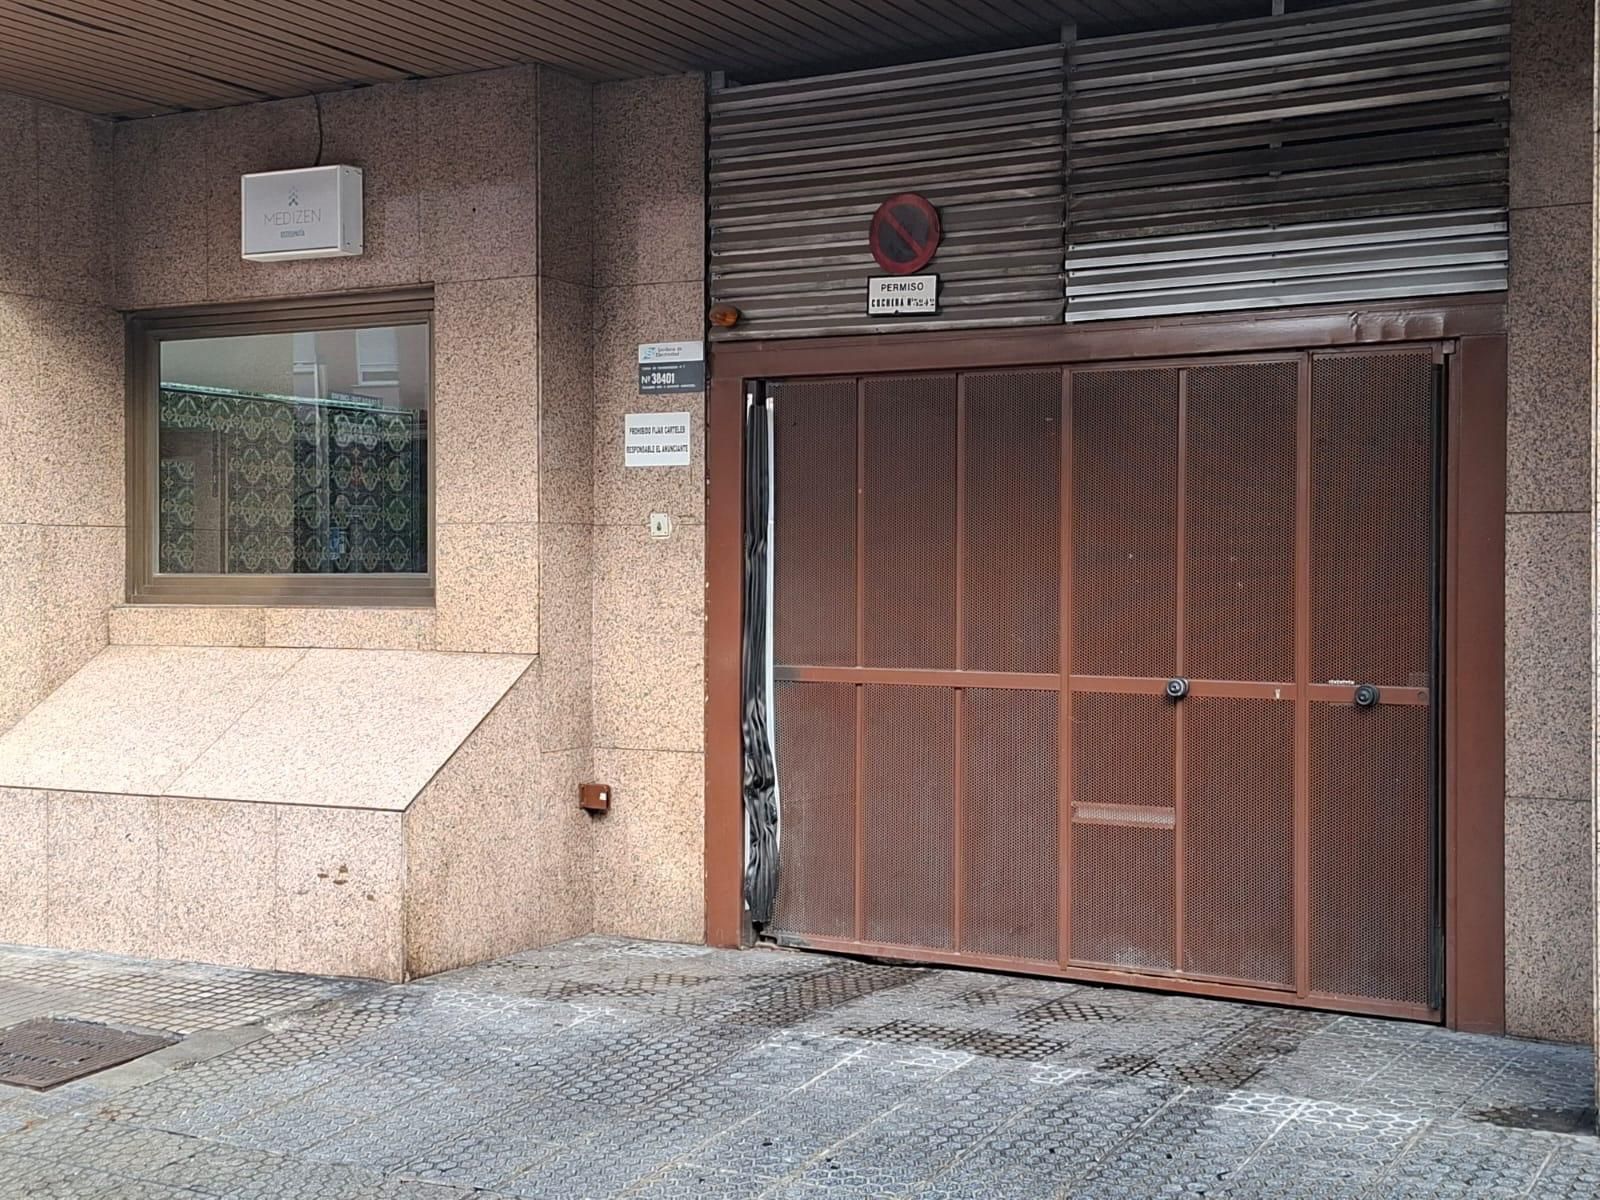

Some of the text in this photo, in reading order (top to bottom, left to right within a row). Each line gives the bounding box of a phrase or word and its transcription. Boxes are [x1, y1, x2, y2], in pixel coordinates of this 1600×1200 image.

[263, 208, 322, 226] MEDIZEN
[880, 282, 924, 292] PERMISO
[651, 373, 675, 384] 38401
[664, 426, 685, 434] CARTELES
[662, 444, 688, 453] ANUNCIANTE
